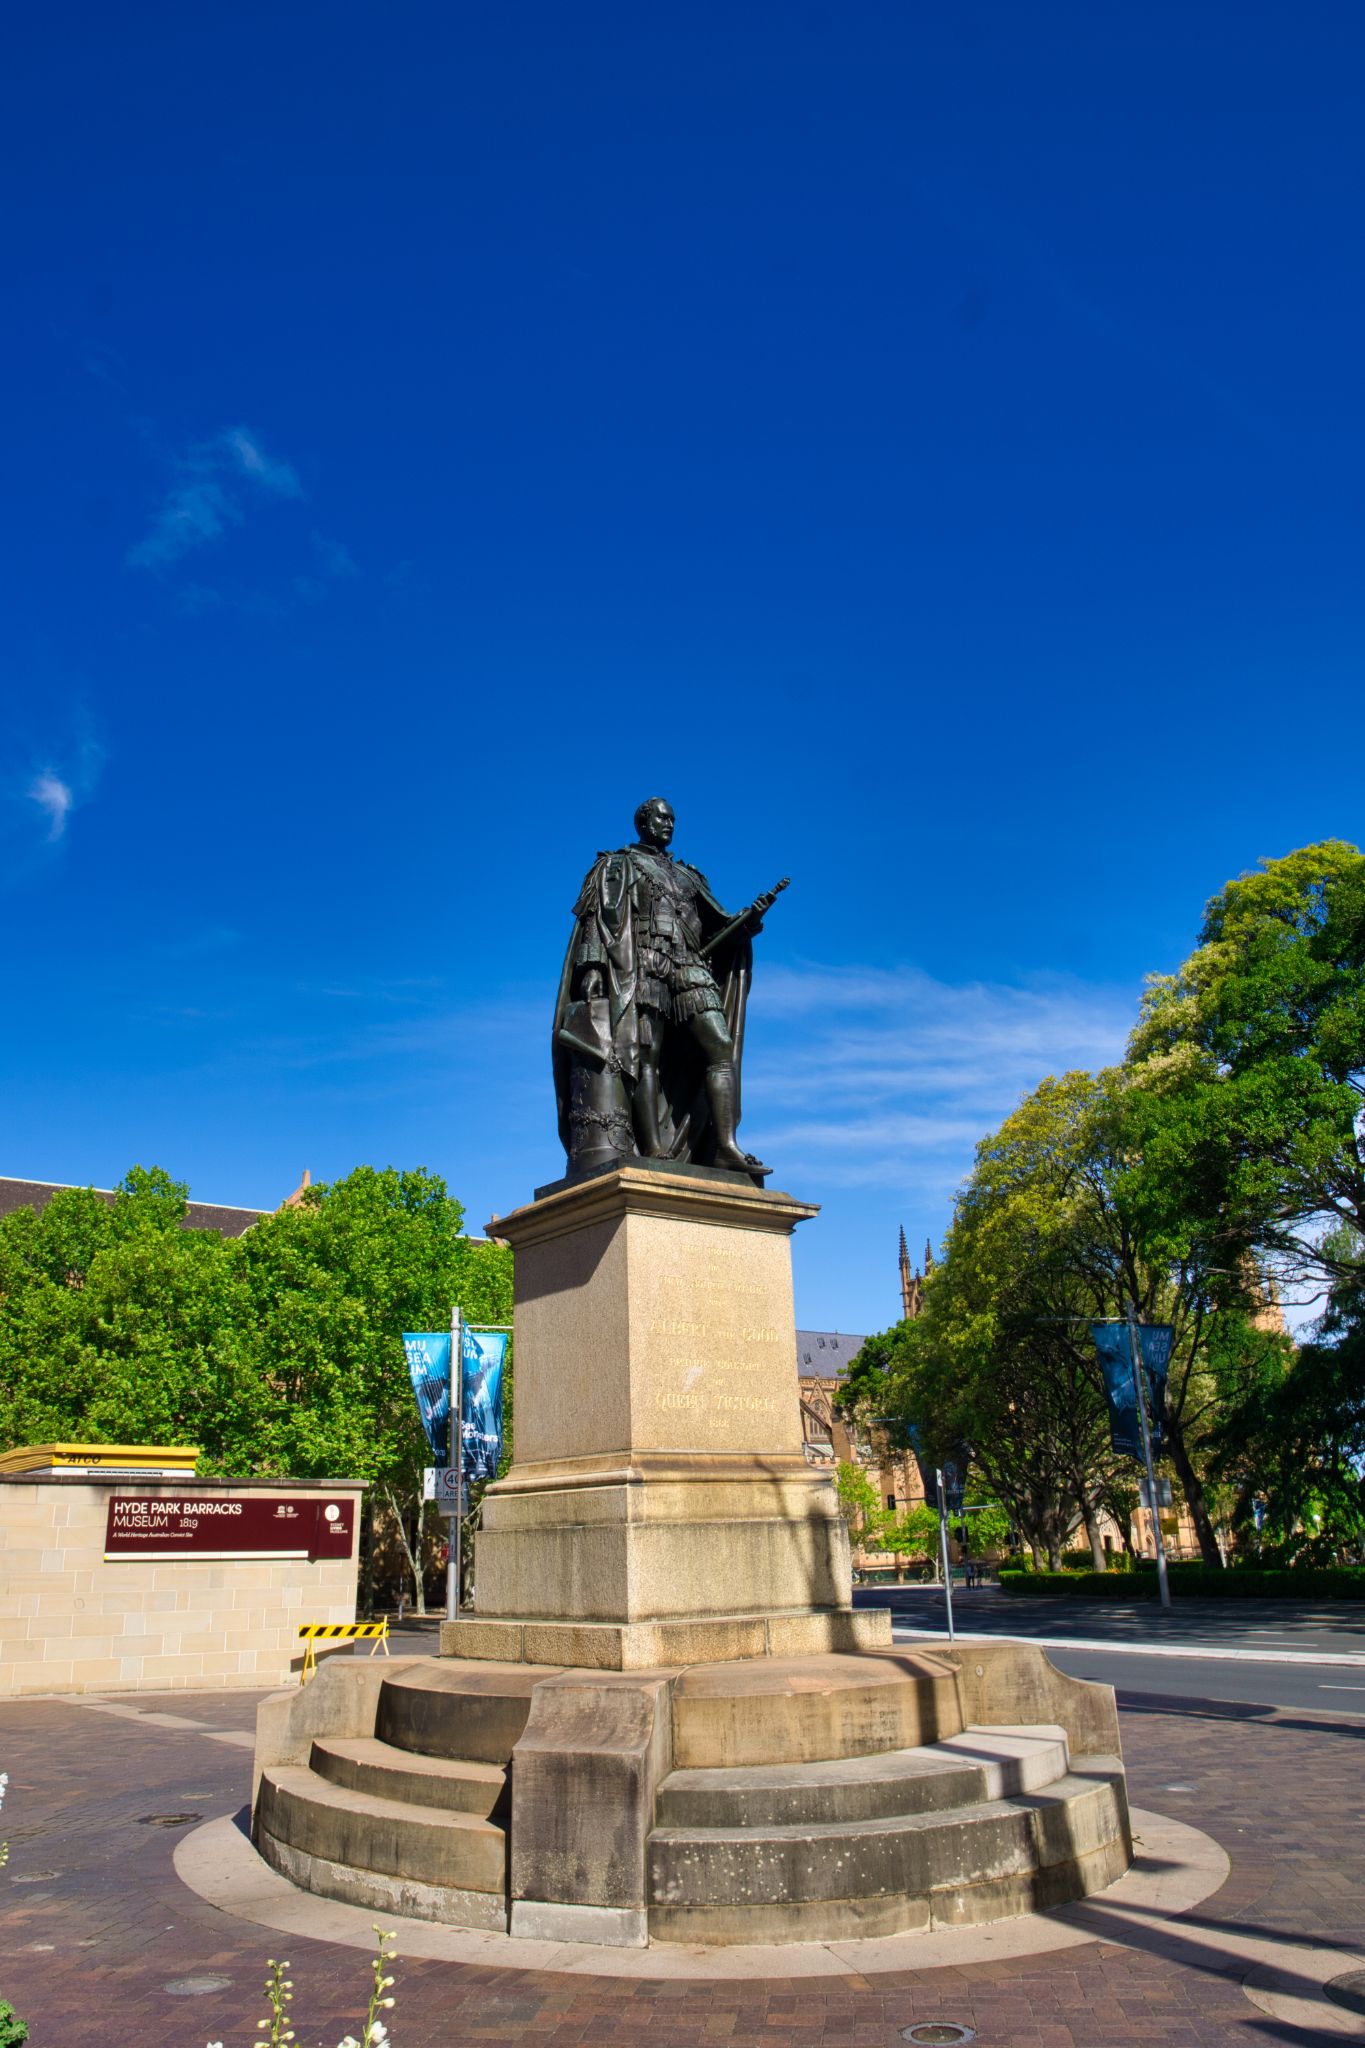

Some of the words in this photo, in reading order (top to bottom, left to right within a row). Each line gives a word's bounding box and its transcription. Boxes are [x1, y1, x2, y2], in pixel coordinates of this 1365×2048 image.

[405, 1340, 426, 1351] MU
[406, 1352, 431, 1364] SEA
[67, 1455, 102, 1465] ATCO
[114, 1503, 148, 1514] HYDE
[151, 1503, 180, 1514] PARK
[183, 1503, 242, 1515] BARRACKS
[113, 1515, 168, 1527] MUSEUM
[179, 1517, 198, 1529] 1819
